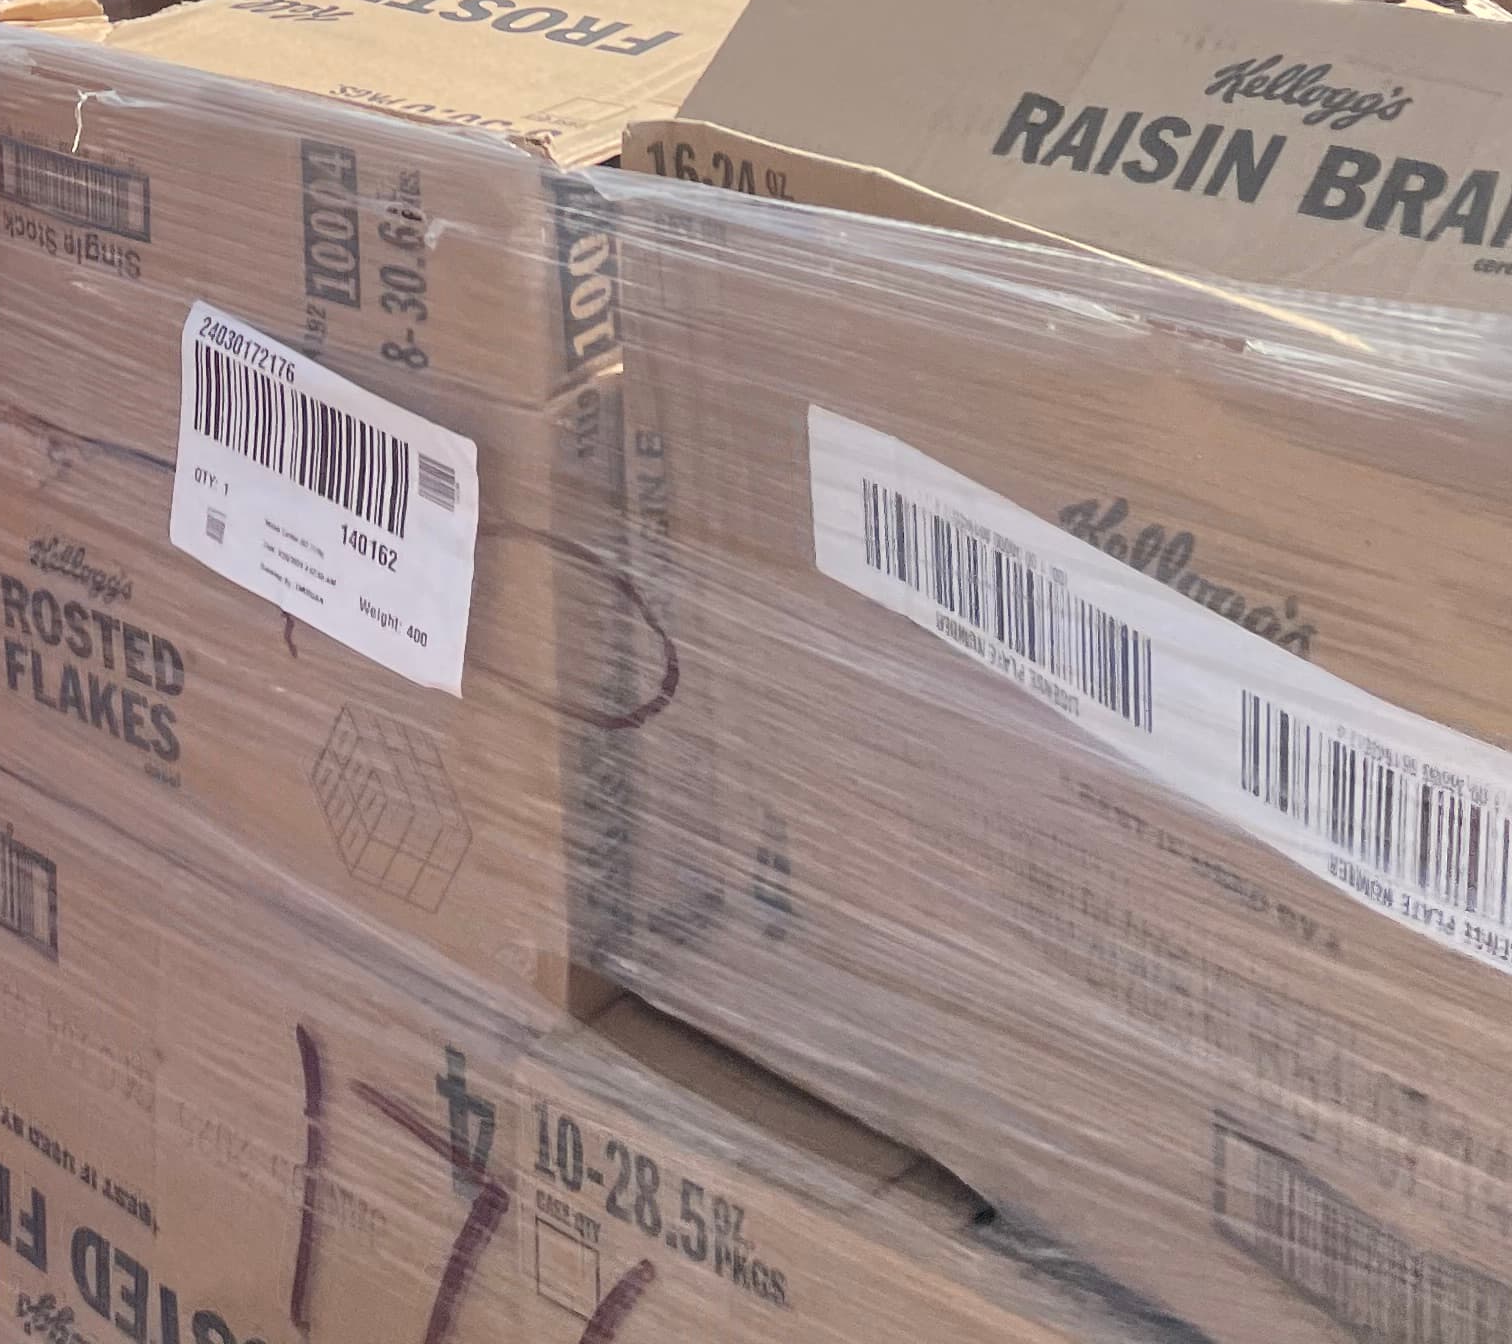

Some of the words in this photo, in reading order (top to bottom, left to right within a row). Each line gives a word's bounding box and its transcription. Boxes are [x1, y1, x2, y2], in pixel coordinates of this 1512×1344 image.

[1205, 54, 1414, 130] Kellogg's
[991, 92, 1286, 206] RAISIN
[3, 213, 59, 258] Stock
[64, 233, 143, 281] Single
[199, 316, 296, 384] 24030172176
[194, 466, 220, 490] QTY:
[340, 522, 399, 573] 140162
[359, 595, 403, 640] Weight:
[405, 624, 429, 648] 400
[4, 636, 181, 763] FLAKES
[104, 1178, 151, 1225] BEST
[534, 1102, 708, 1262] 10-28.5
